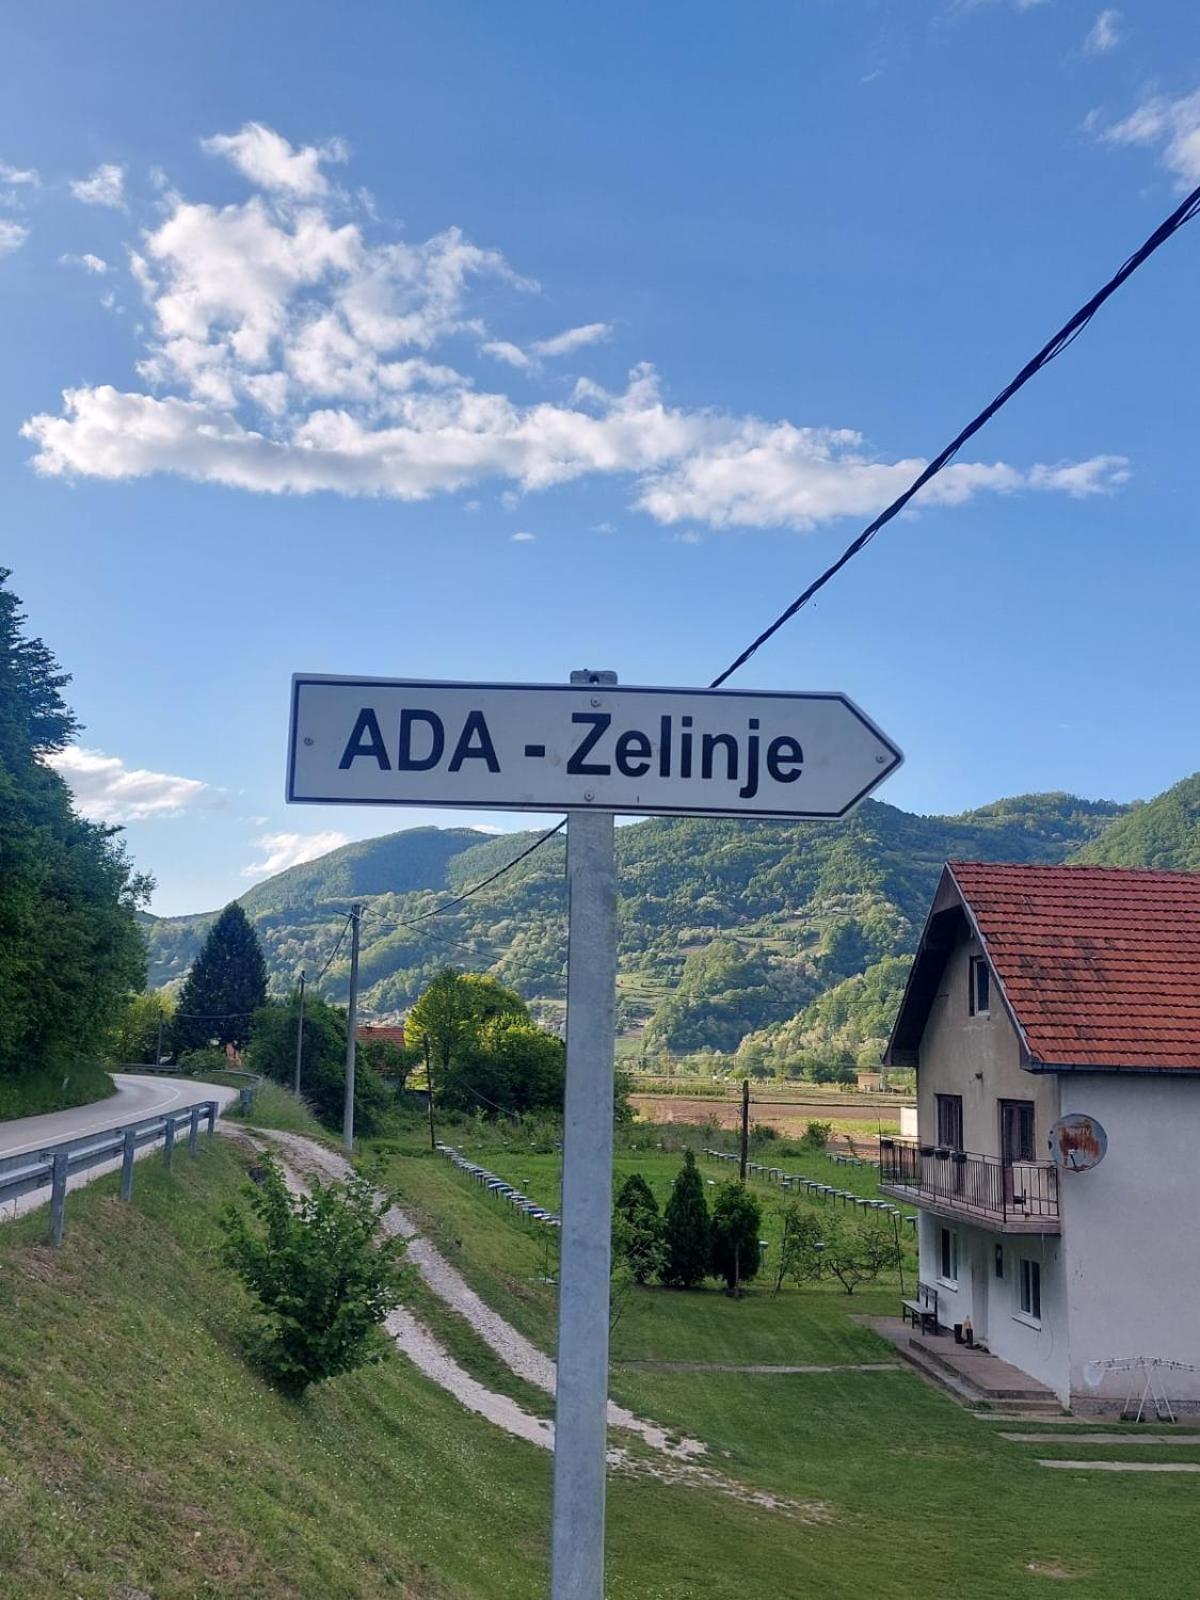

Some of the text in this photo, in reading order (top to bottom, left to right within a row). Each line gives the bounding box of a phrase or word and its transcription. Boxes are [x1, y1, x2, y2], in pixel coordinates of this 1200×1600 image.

[337, 707, 805, 800] ADA - Zelinje
